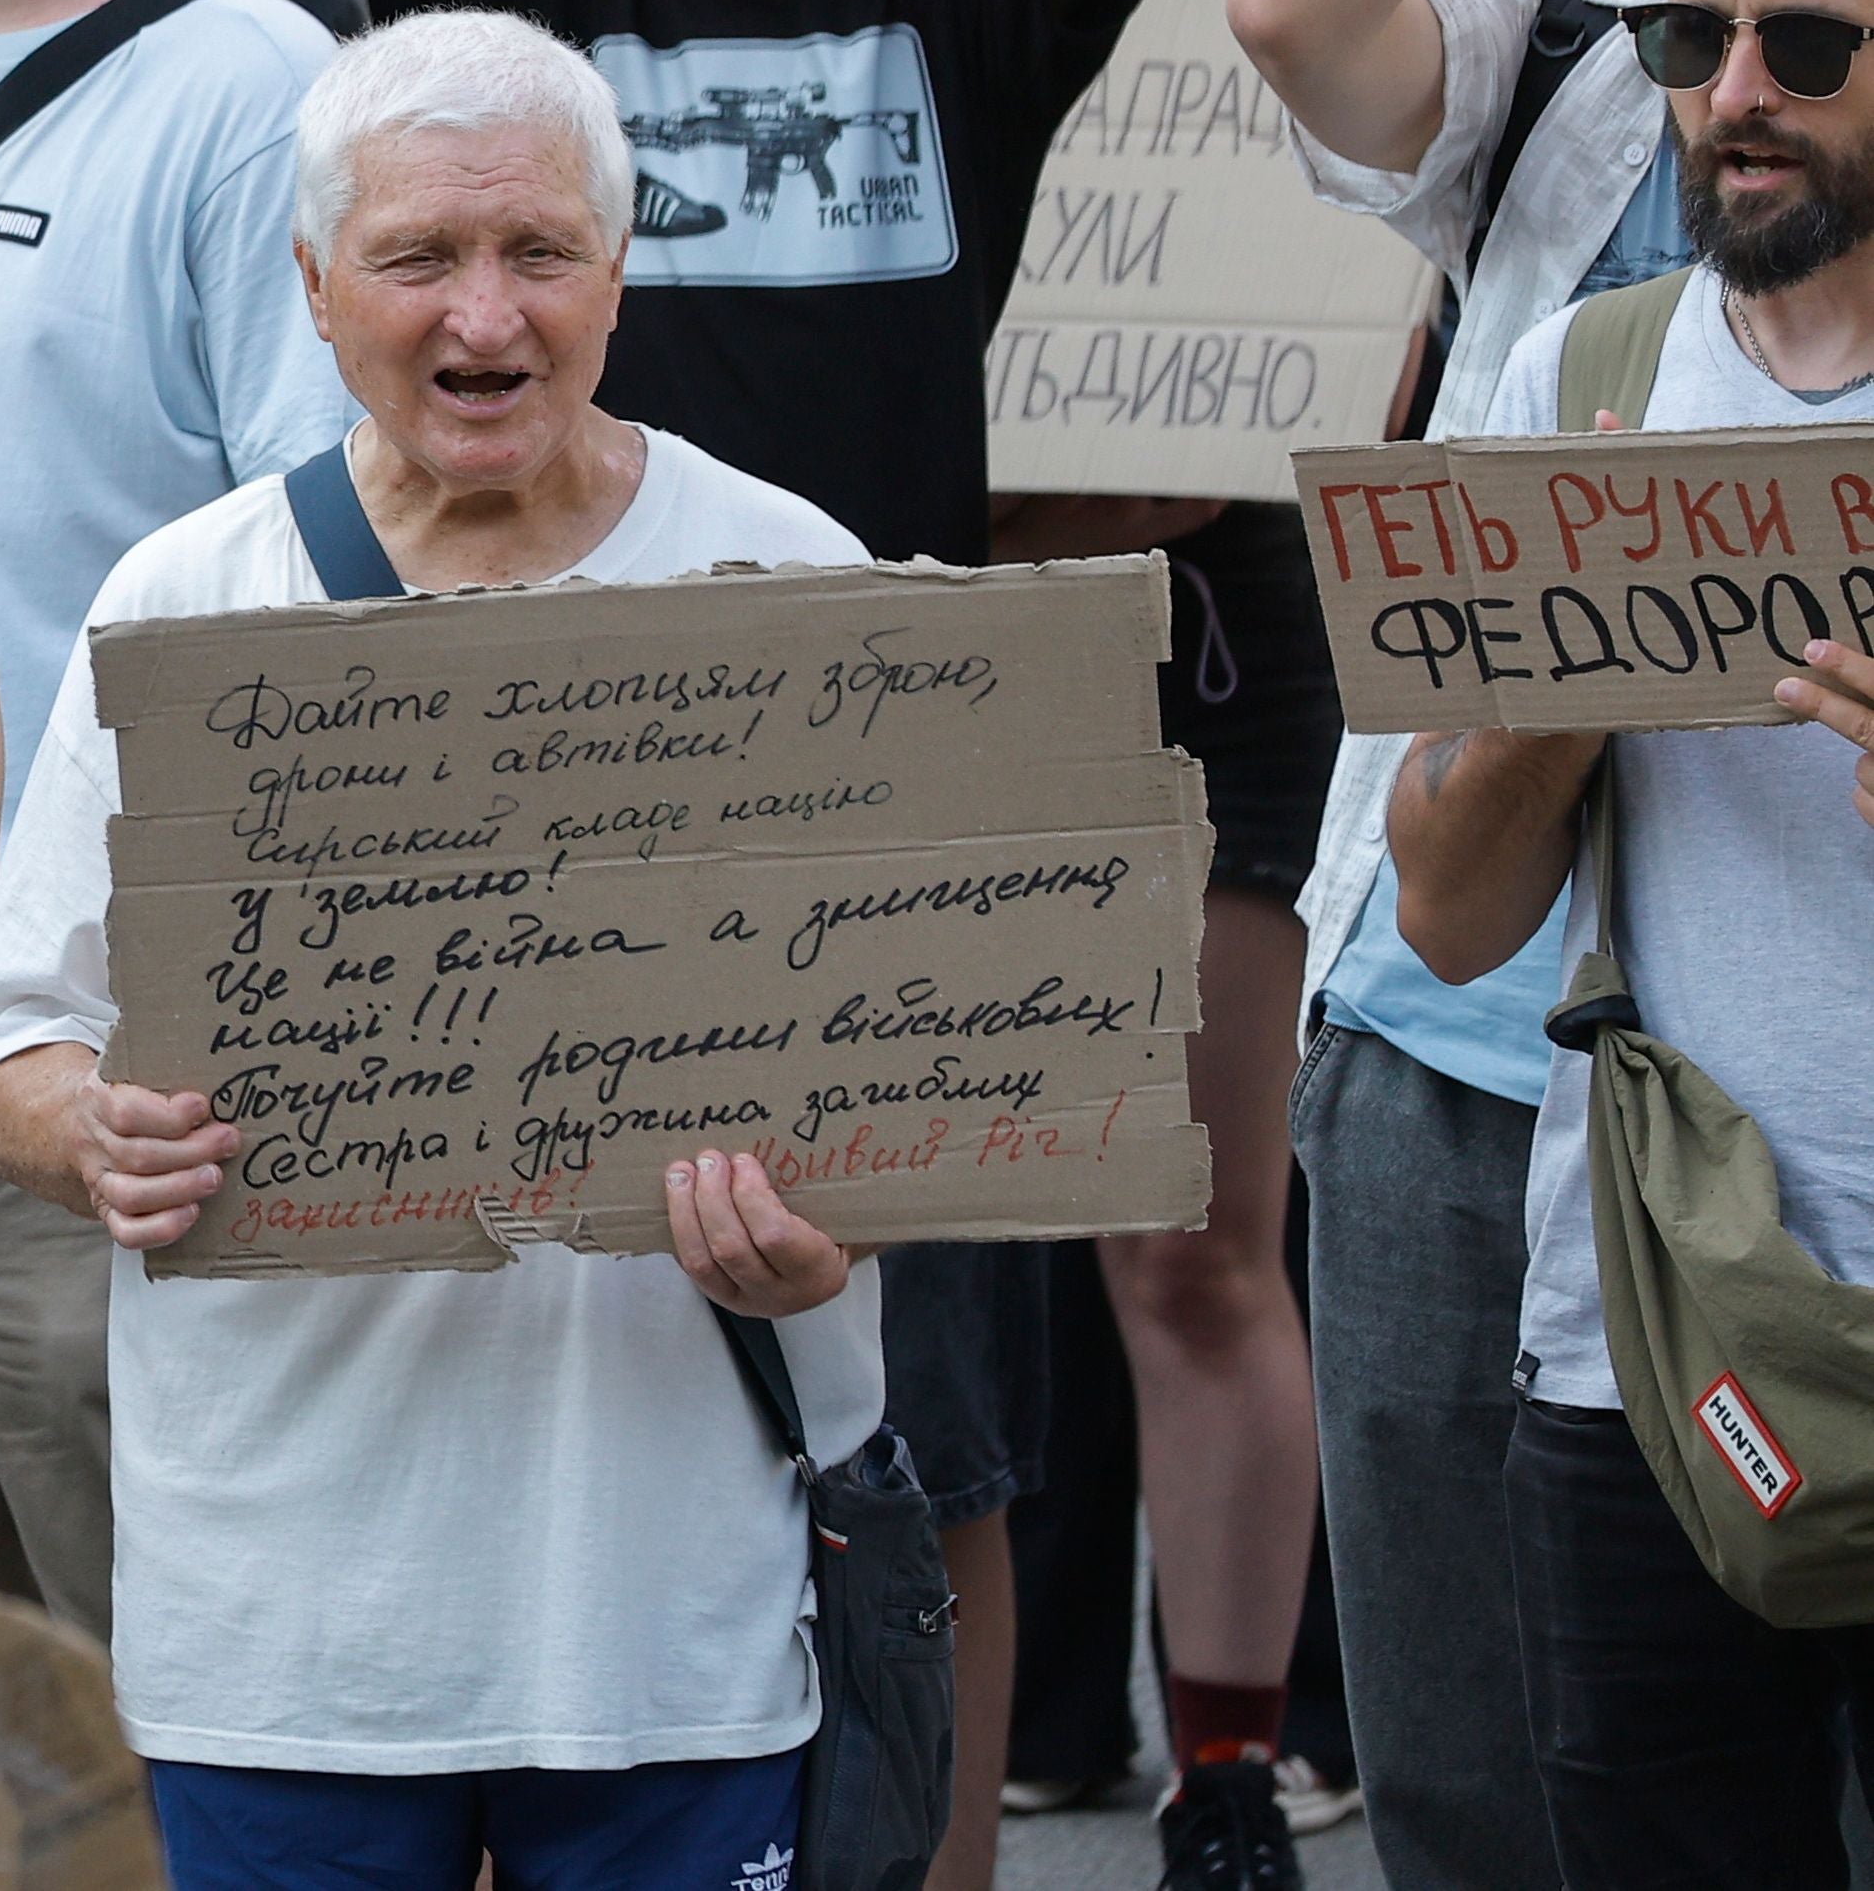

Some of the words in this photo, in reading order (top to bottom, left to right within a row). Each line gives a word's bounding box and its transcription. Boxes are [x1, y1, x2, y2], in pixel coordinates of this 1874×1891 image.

[1317, 477, 1520, 584] ГЕТЬ
[1547, 470, 1798, 575] РУКИ
[323, 953, 397, 988] не
[1707, 1394, 1779, 1497] HUNTER
